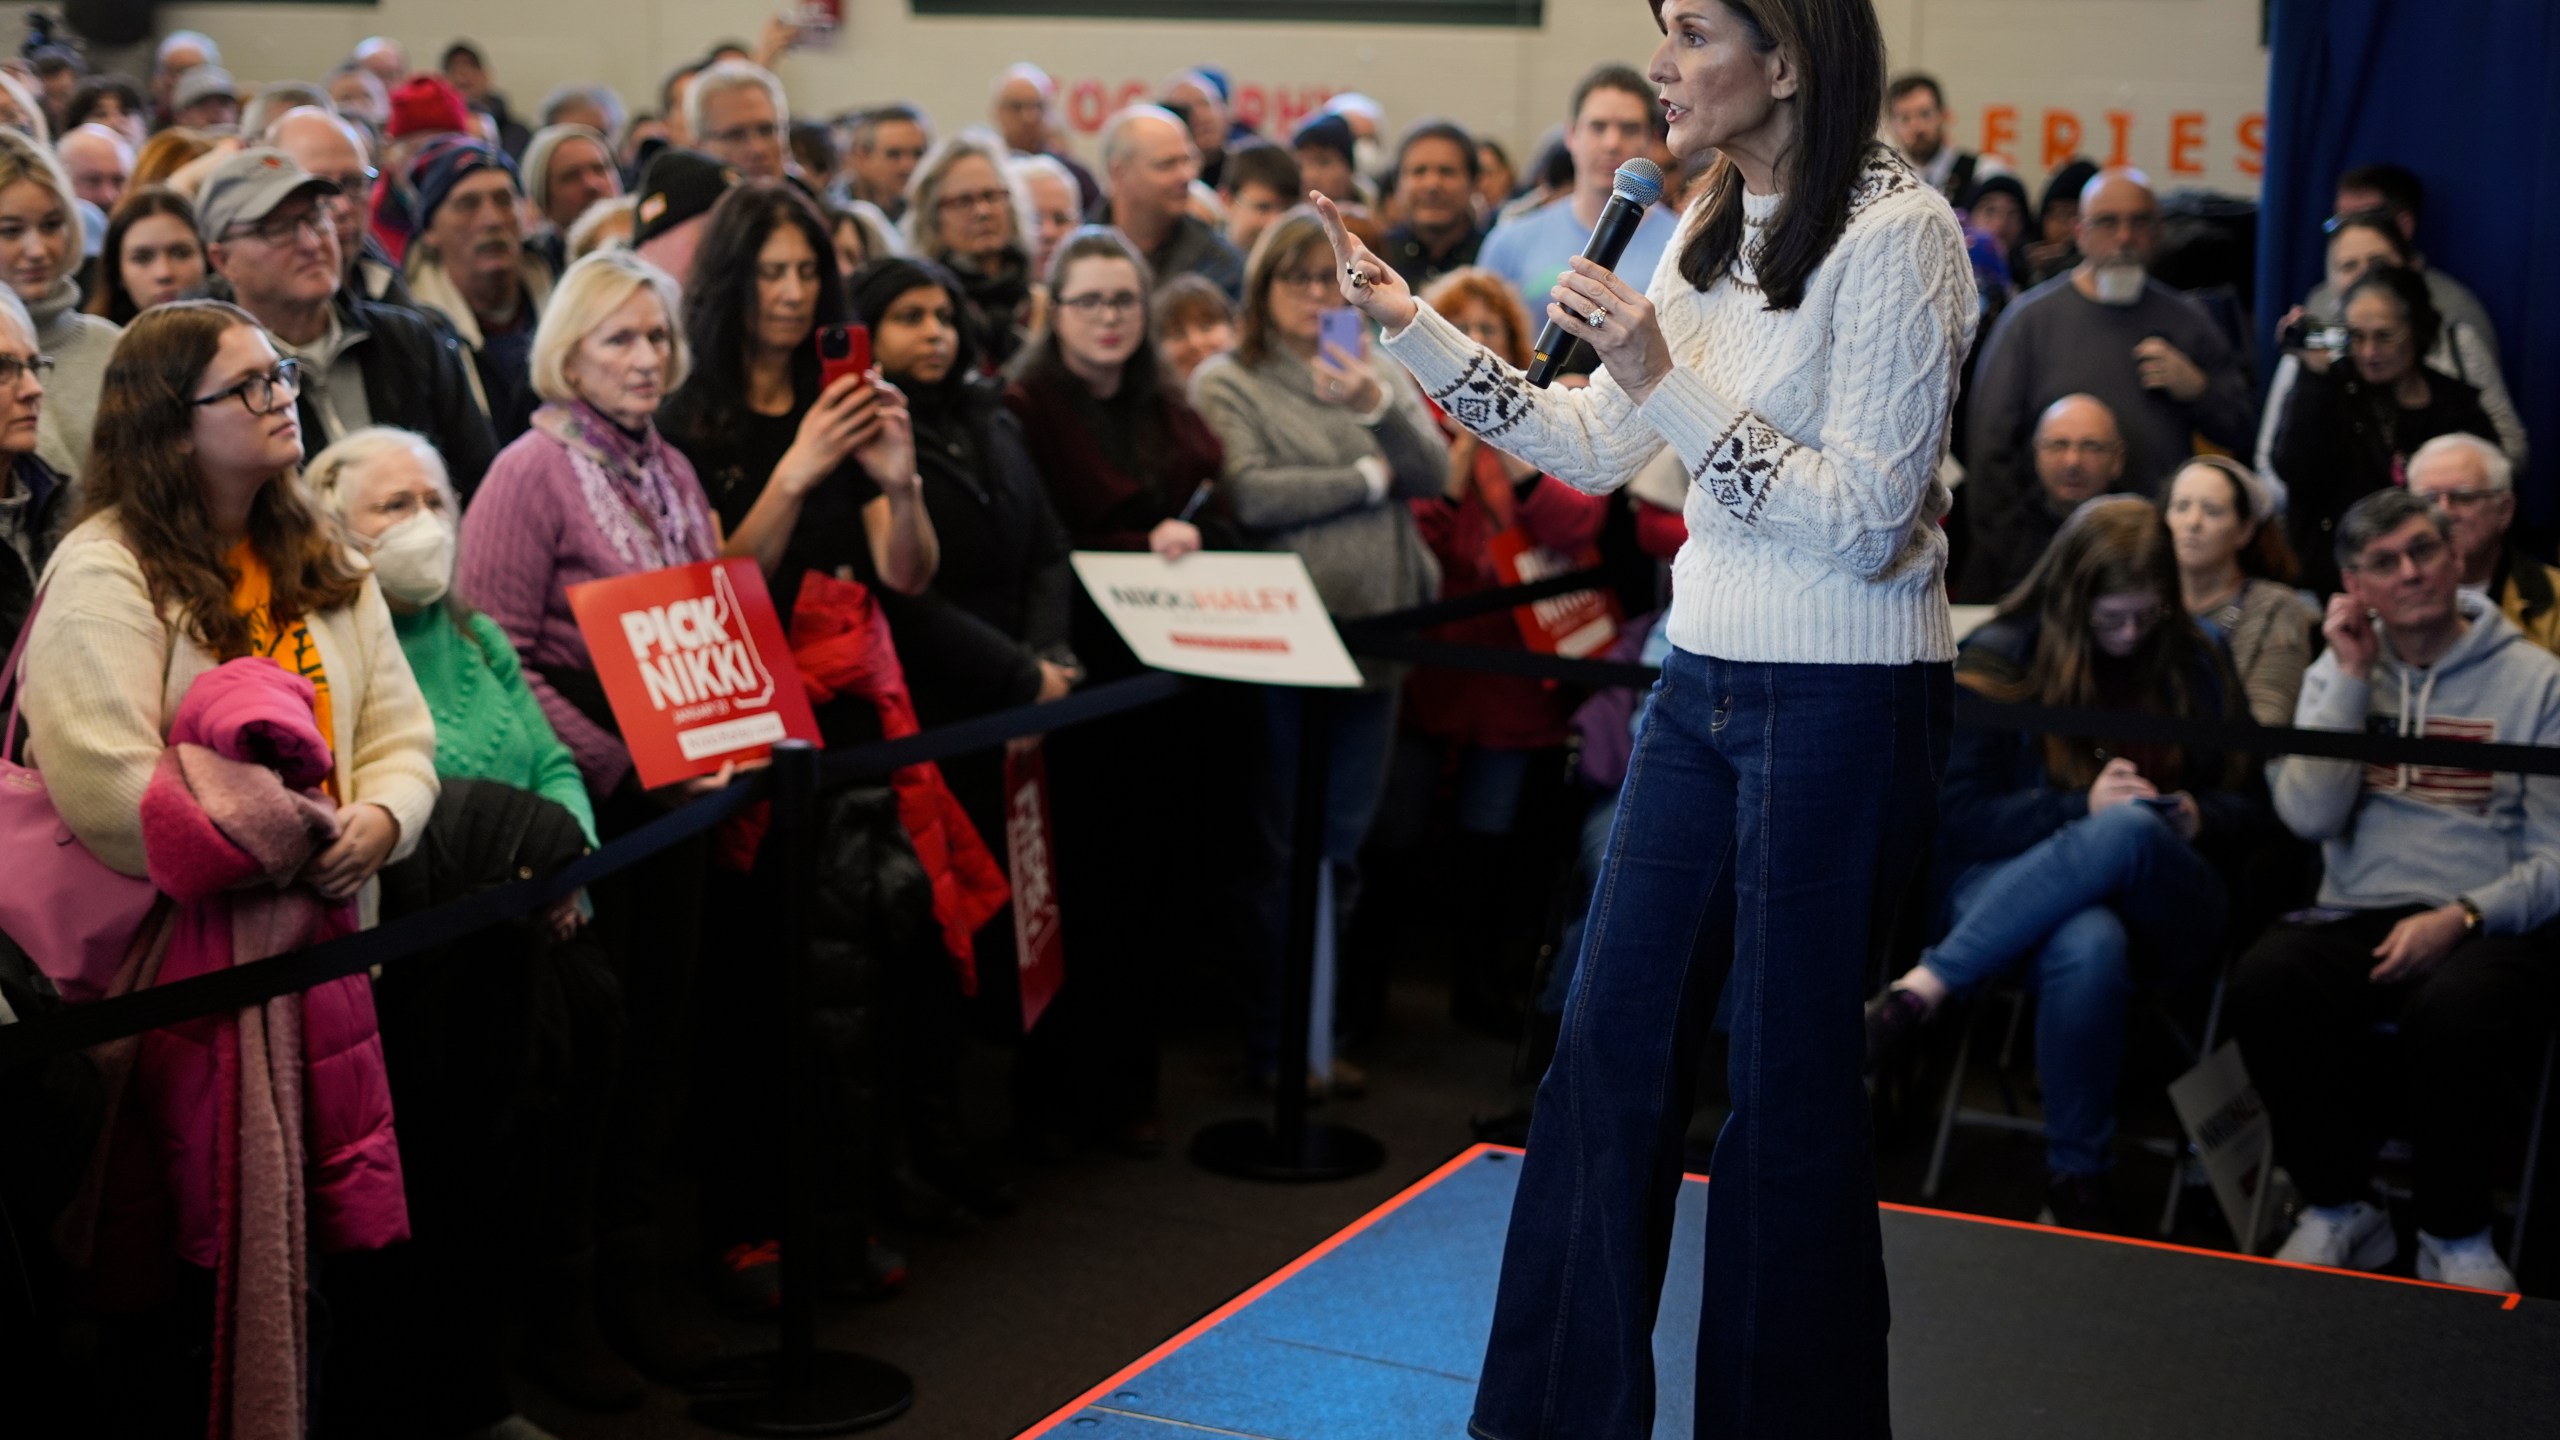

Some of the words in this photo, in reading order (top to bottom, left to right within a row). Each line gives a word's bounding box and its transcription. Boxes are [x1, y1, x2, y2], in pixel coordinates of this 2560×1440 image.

[1942, 106, 2267, 176] ERIES
[620, 595, 730, 660] PICK
[638, 640, 758, 711] NIKKI
